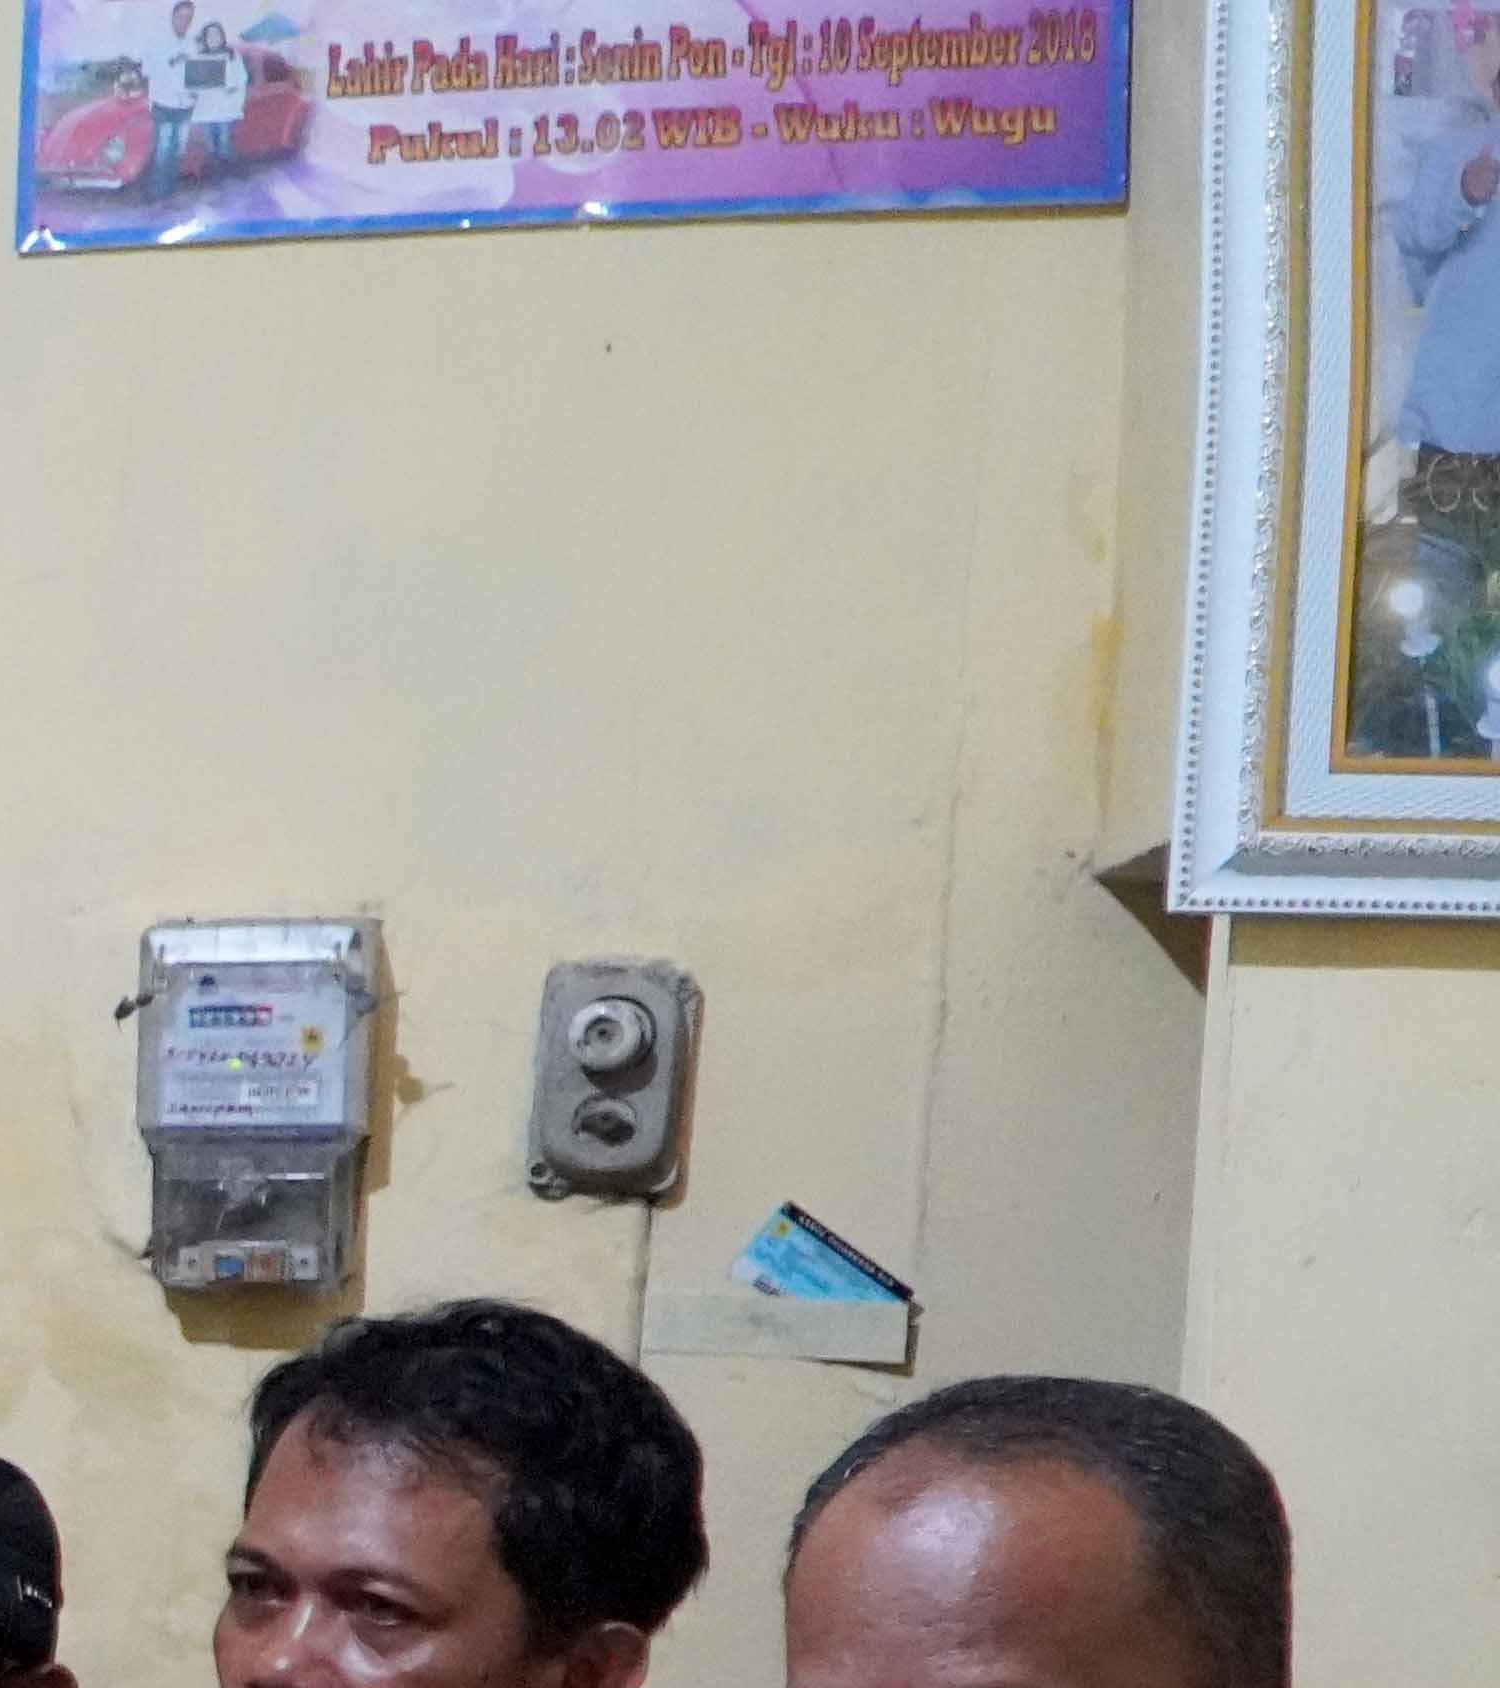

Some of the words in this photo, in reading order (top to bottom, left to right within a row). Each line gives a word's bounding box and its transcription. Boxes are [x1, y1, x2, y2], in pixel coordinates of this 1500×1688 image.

[326, 40, 408, 98] Lahir
[411, 34, 488, 94] Pada
[494, 30, 560, 89] Hari
[578, 25, 663, 88] Senin
[668, 23, 727, 81] Pon
[748, 18, 798, 92] Tgl
[818, 15, 853, 74] 10
[857, 11, 1023, 87] September
[1026, 9, 1100, 67] 2018
[367, 116, 499, 165] Pukul
[533, 109, 646, 157] 13.02
[651, 106, 742, 148] WIB
[773, 99, 901, 146] Wuku
[928, 96, 1060, 150] Wugu
